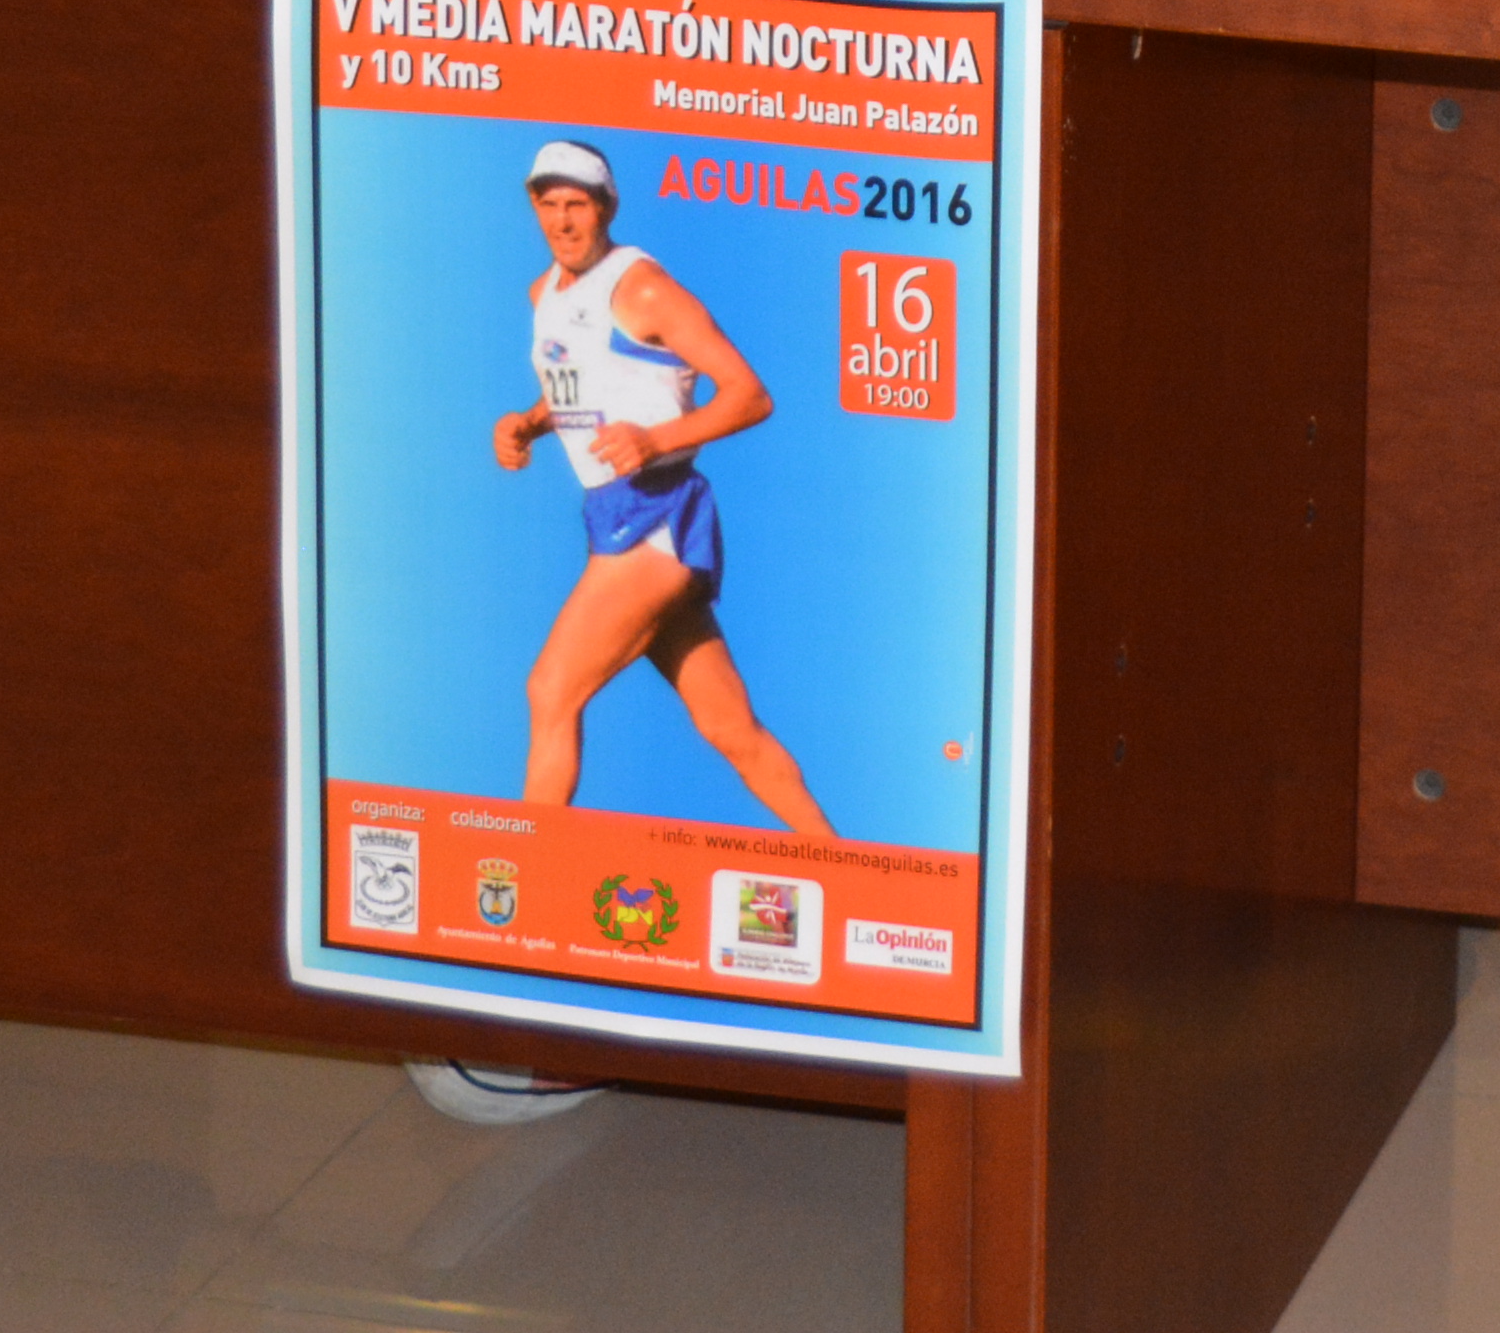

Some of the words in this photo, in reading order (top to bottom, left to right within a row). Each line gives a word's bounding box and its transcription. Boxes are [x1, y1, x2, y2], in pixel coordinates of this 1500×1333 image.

[340, 55, 360, 90] y
[372, 51, 412, 86] 10
[421, 54, 501, 92] Kms
[742, 20, 982, 85] NOCTURNA
[654, 80, 785, 121] Memorial
[793, 93, 859, 128] Juan
[866, 101, 979, 137] Palazón
[856, 262, 933, 333] 16
[848, 333, 940, 383] abril
[863, 382, 930, 411] 19:00
[352, 798, 425, 822] organiza:
[451, 809, 536, 834] colaboran:
[662, 829, 697, 847] info:
[705, 835, 959, 878] www.clubatletismoaguilas.es
[437, 925, 501, 943] Ayuntamiento
[505, 931, 517, 944] de
